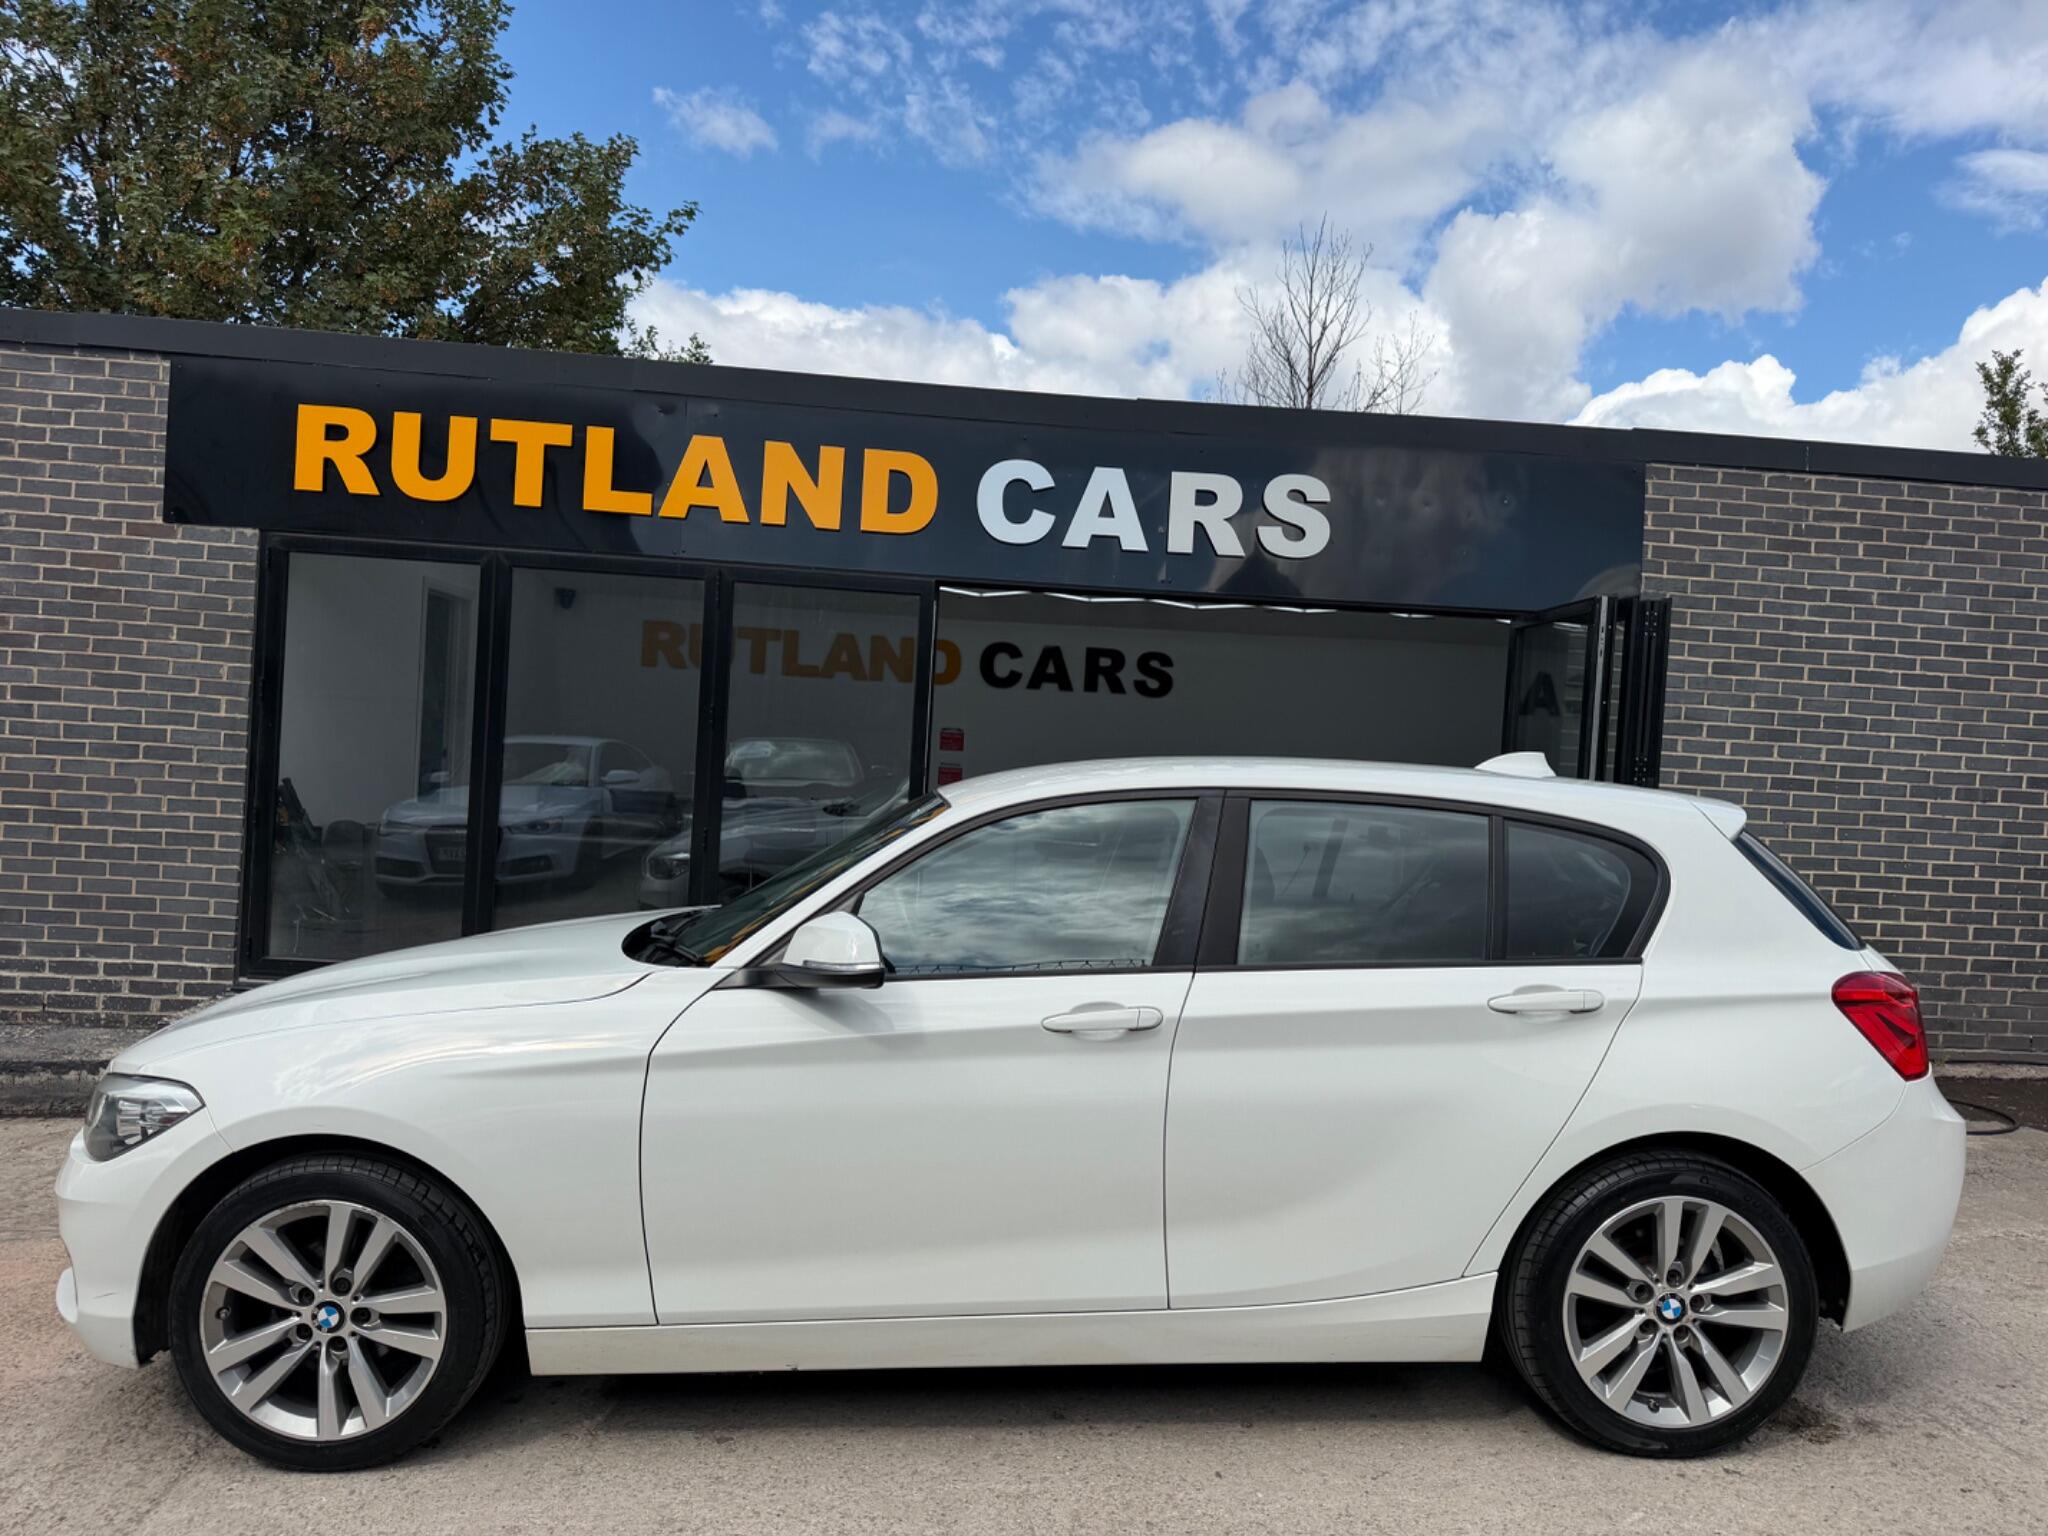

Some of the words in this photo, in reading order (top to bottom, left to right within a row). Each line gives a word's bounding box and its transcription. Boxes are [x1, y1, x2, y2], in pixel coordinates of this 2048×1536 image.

[294, 404, 939, 534] RUTLAND
[977, 459, 1331, 559] CARS
[979, 641, 1174, 698] CARS
